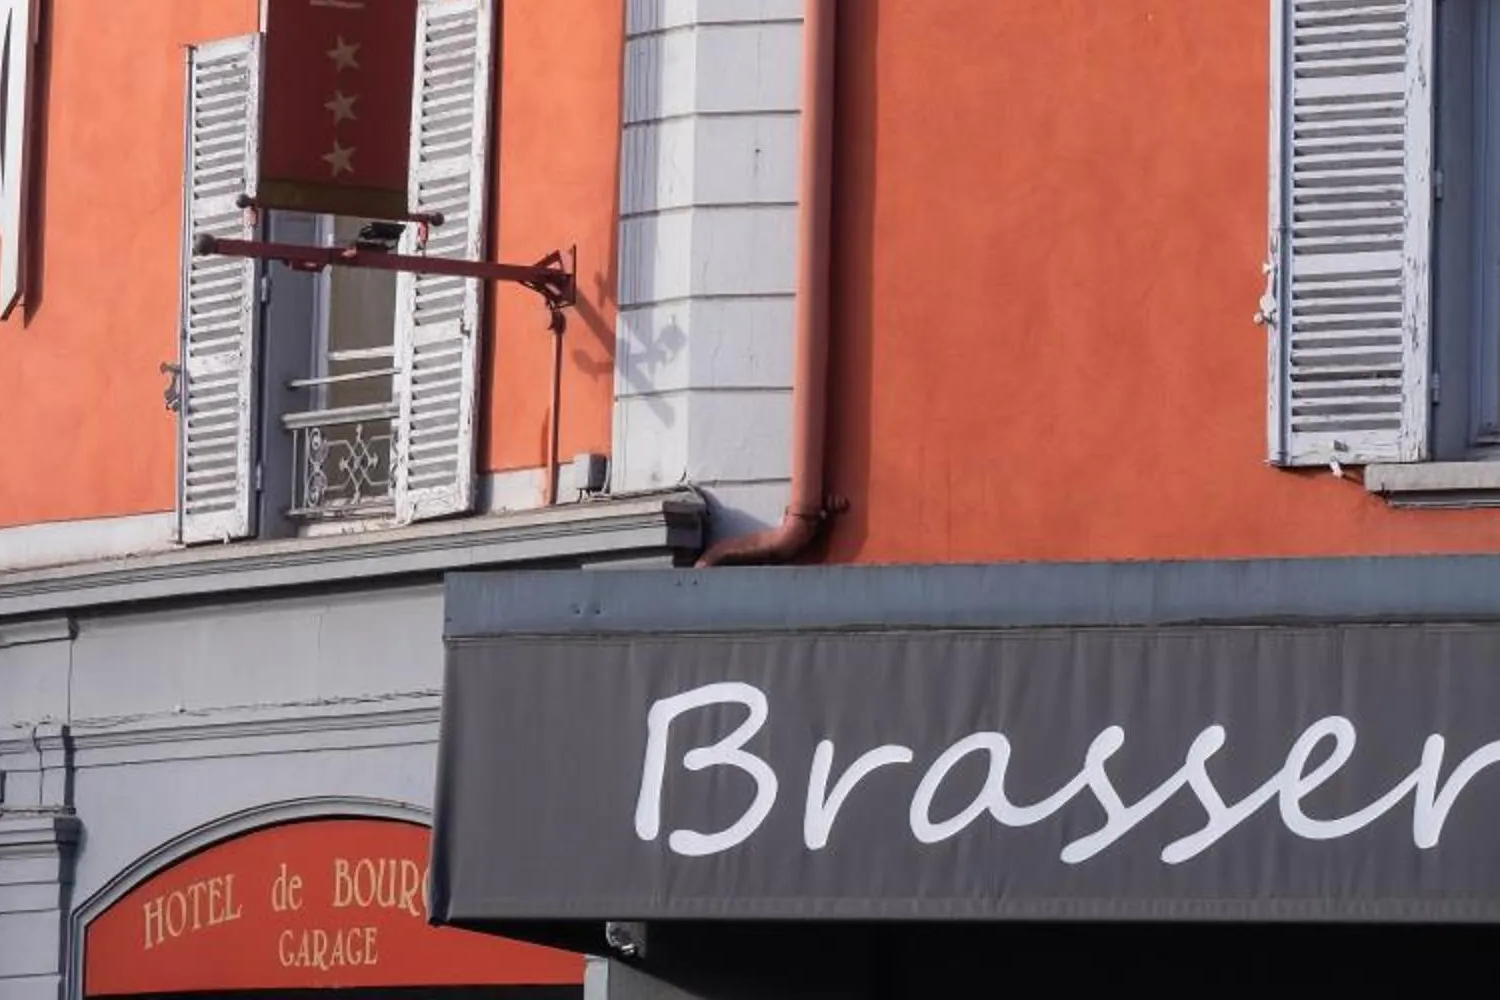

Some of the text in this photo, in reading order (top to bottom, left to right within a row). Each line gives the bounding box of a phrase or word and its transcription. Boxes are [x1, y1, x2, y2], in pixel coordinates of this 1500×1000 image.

[634, 681, 1500, 865] Brasser
[142, 873, 243, 950] HOTEL
[271, 863, 303, 912] de
[278, 927, 379, 971] GARAGE
